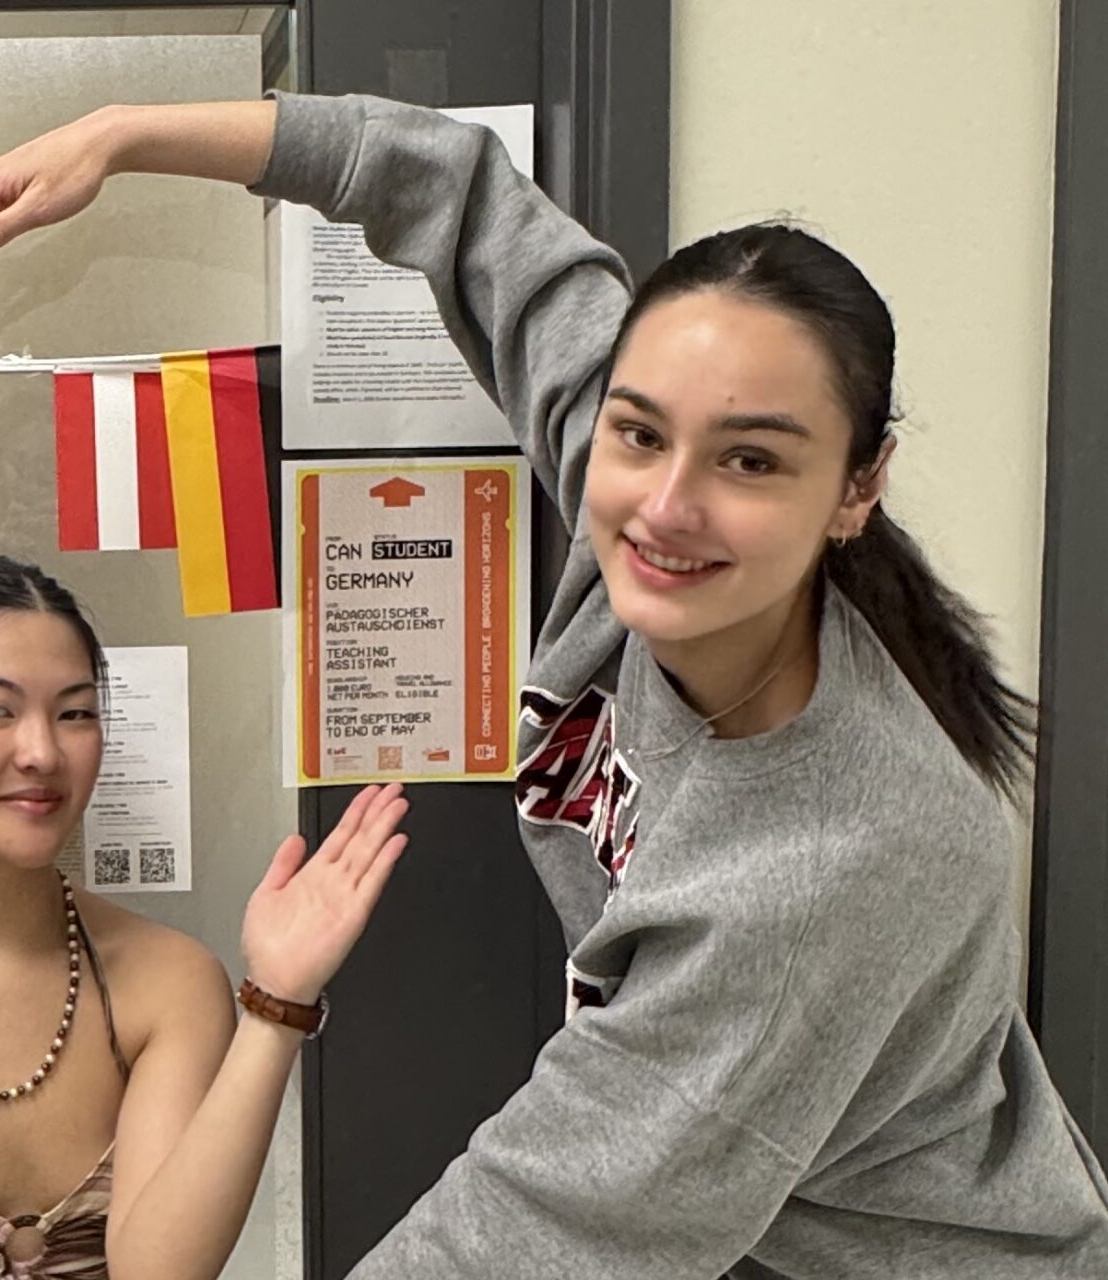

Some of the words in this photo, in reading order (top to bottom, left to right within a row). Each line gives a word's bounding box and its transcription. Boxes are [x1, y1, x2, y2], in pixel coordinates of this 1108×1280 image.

[482, 511, 492, 563] HORIZONS
[326, 543, 362, 561] CAN
[373, 541, 451, 558] STUDENT
[326, 571, 414, 590] GERMANY
[482, 565, 492, 629] BROADENING
[326, 619, 445, 633] AUSTAUSCHDIENST
[326, 646, 389, 659] TEACHING
[326, 657, 397, 671] ASSISTANT
[351, 683, 372, 692] EURO
[395, 690, 439, 699] ELIGIBLE
[327, 692, 343, 701] NET
[344, 692, 360, 700] PER
[362, 691, 389, 700] MONTH
[482, 674, 492, 738] CONNECTING
[326, 715, 357, 726] FROM
[360, 712, 432, 725] SEPTEMBER
[326, 727, 342, 738] TO
[345, 726, 368, 737] END
[371, 725, 388, 736] OF
[391, 725, 416, 735] MAY
